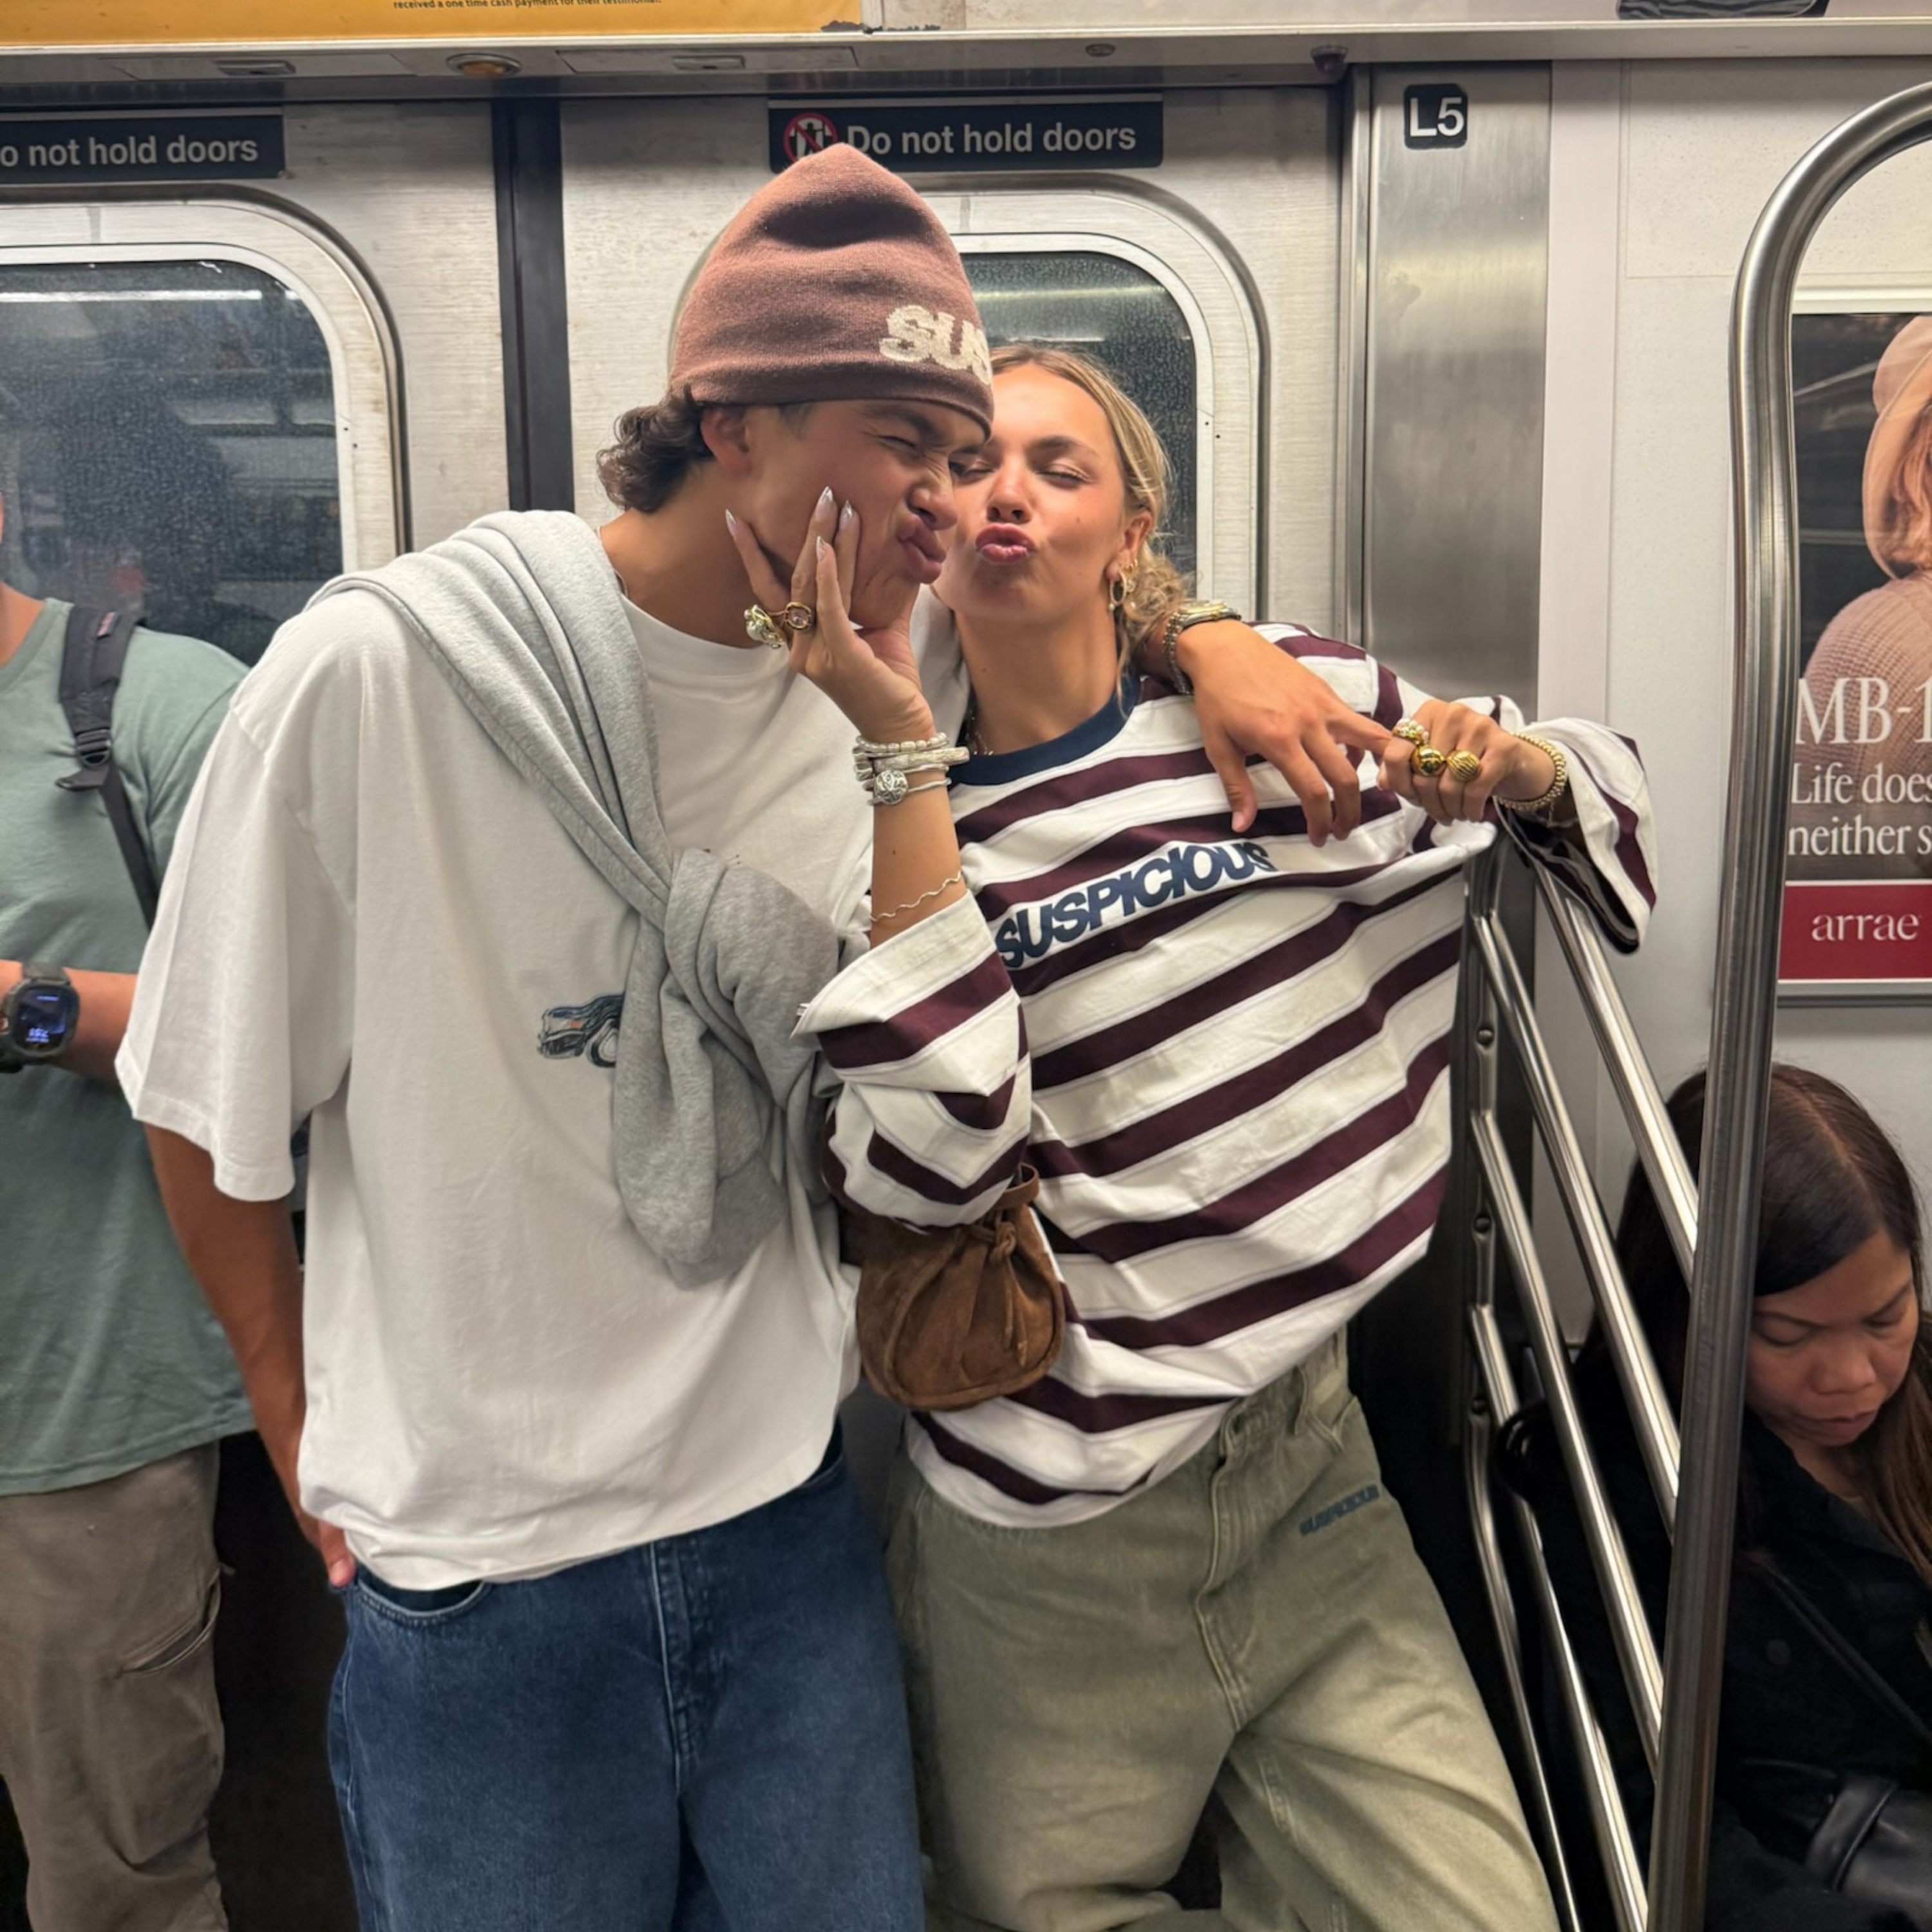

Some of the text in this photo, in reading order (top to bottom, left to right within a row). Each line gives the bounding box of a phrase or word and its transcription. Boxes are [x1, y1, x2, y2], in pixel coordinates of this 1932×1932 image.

[393, 0, 435, 8] received
[1410, 96, 1464, 137] L5
[0, 135, 258, 167] o not hold doors
[848, 122, 1136, 155] Do not hold doors
[1791, 762, 1853, 804] Life
[1788, 813, 1911, 855] neither
[994, 842, 1278, 969] SUSPICIOUS
